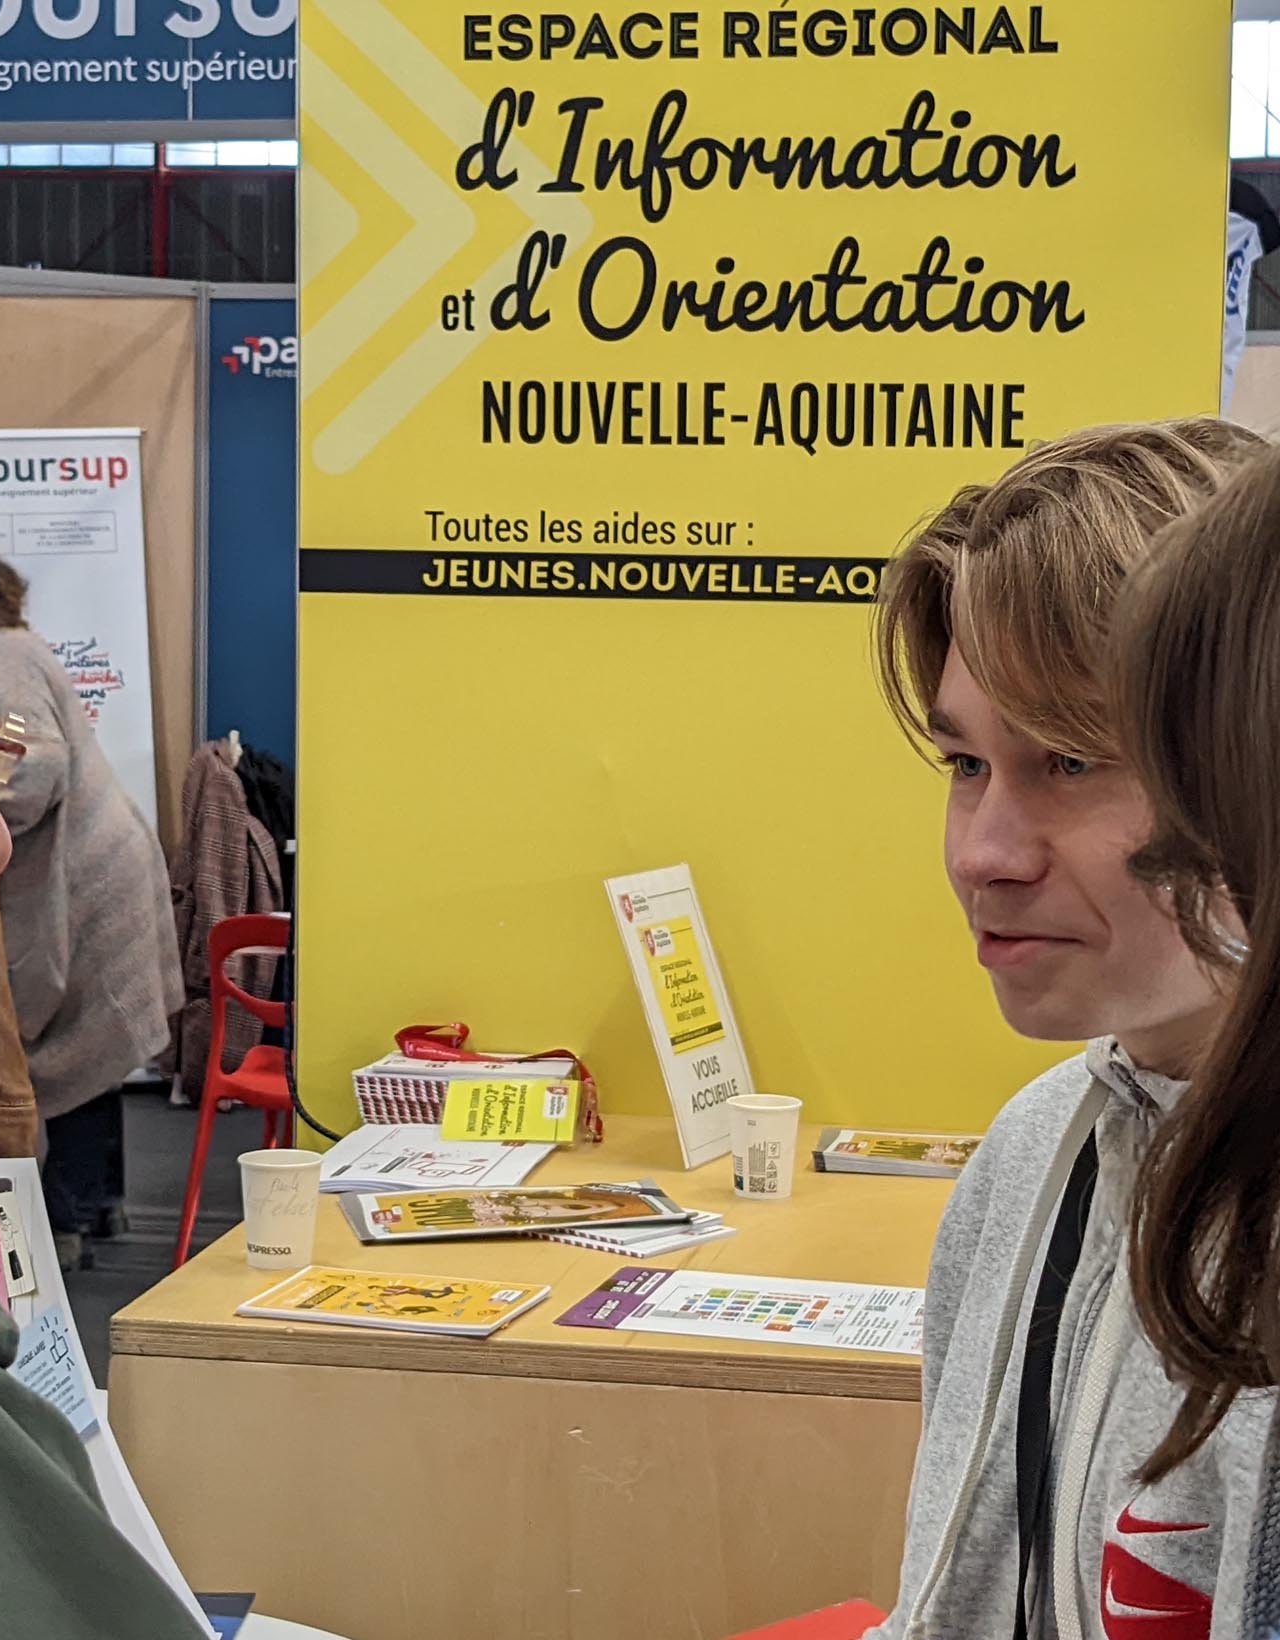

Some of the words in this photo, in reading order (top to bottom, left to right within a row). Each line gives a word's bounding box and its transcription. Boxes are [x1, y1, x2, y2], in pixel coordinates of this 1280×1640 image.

[463, 12, 700, 61] ESPACE
[722, 0, 1059, 59] RÉGIONAL
[145, 51, 297, 90] supérieur
[441, 288, 475, 332] et
[481, 380, 1025, 457] NOUVELLE-AQUITAINE
[424, 511, 529, 542] Toutes
[539, 511, 583, 544] les
[593, 511, 677, 545] aides
[687, 519, 738, 546] sur
[422, 559, 889, 596] JEUNES.NOUVELLE-AQ
[692, 1055, 721, 1080] VOUS
[691, 1078, 739, 1114] ACCUEILLE
